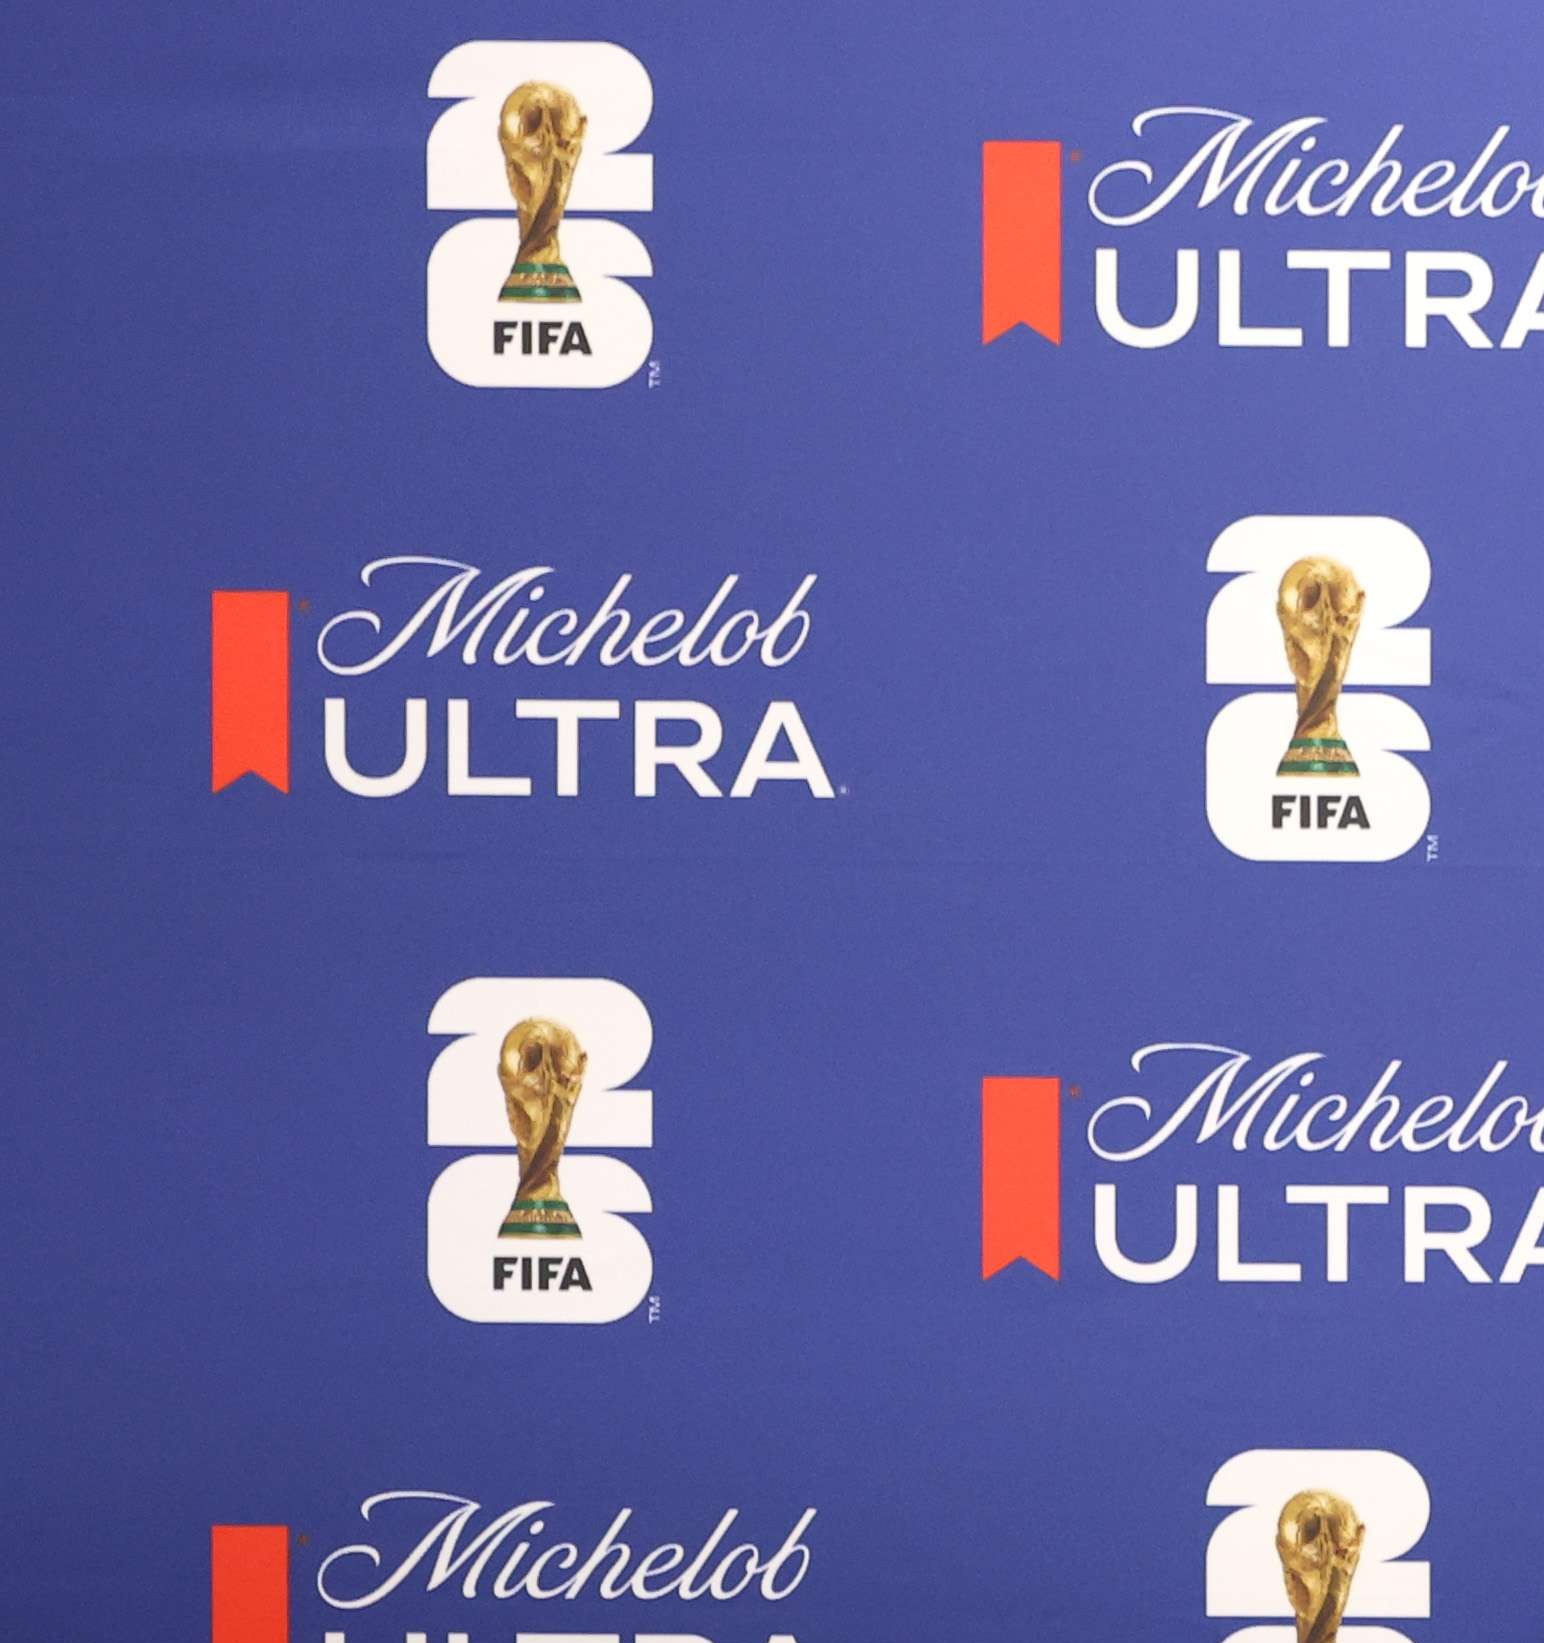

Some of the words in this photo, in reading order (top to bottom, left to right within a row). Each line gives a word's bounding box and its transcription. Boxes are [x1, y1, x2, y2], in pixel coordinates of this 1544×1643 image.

[492, 320, 593, 356] FIFA
[316, 555, 819, 677] Michelob
[323, 697, 836, 800] ULTRA
[1271, 794, 1371, 830] FIFA
[492, 1255, 594, 1292] FIFA
[316, 1489, 818, 1610] Michelob
